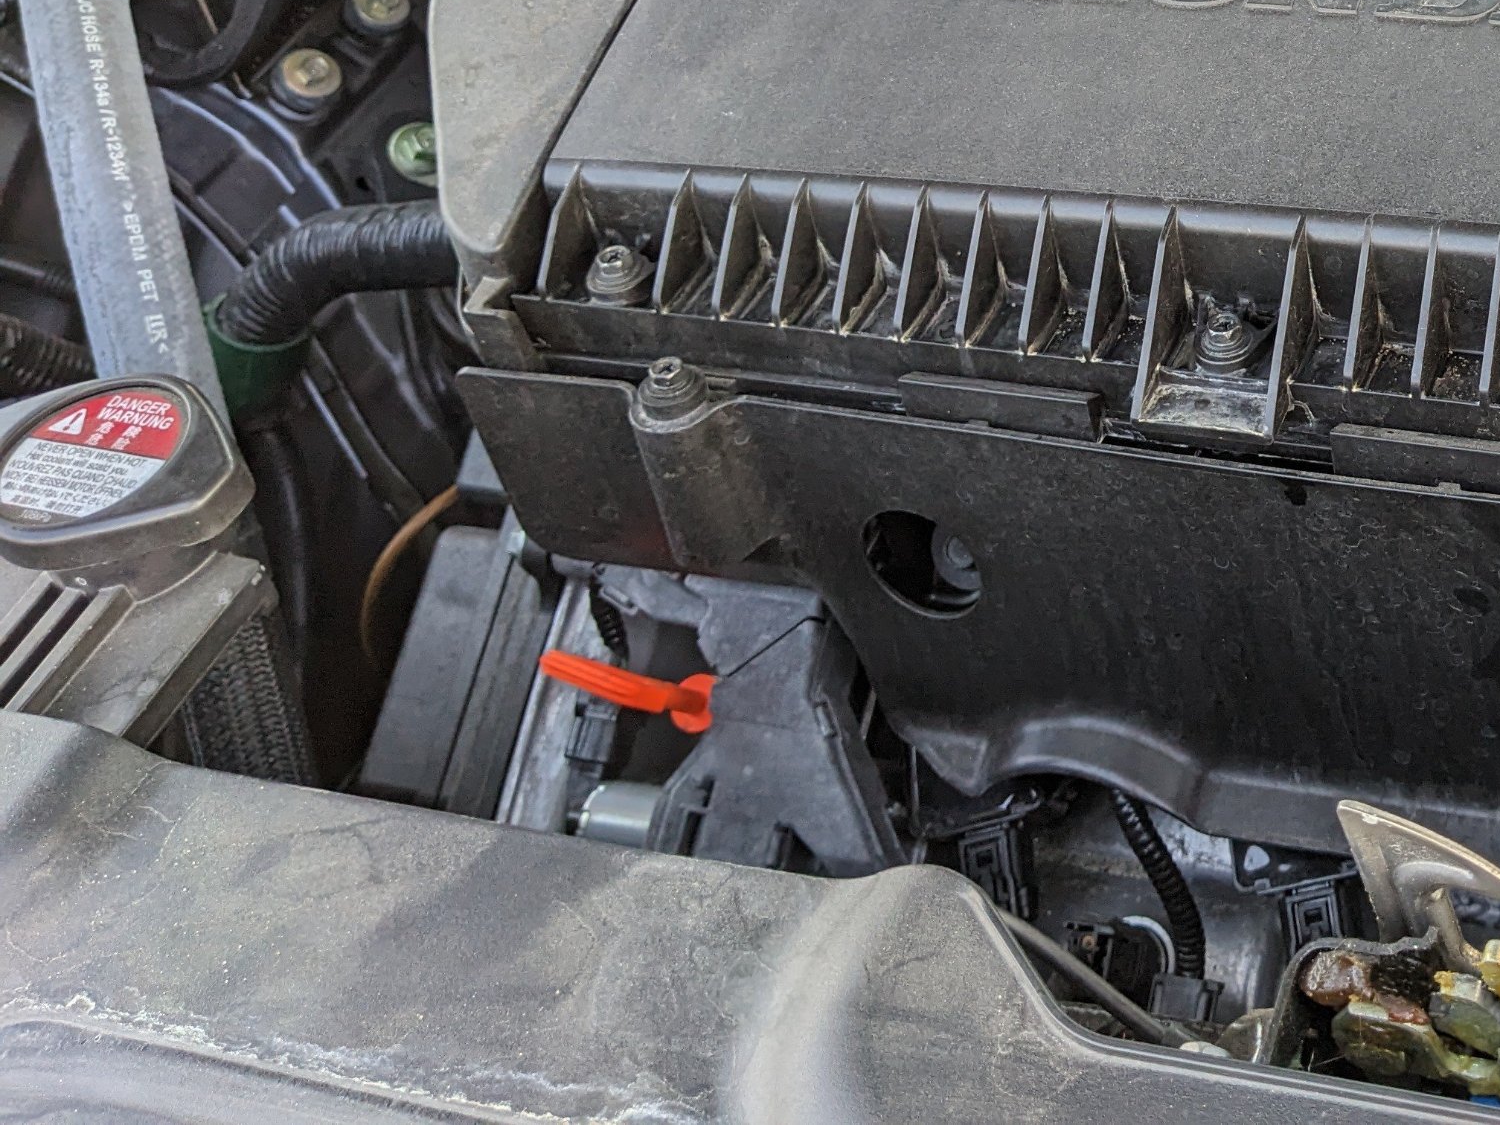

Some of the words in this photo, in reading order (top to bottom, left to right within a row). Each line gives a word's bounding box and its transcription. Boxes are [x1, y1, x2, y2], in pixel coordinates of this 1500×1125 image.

[80, 15, 102, 53] HOSE
[136, 268, 160, 303] PET
[106, 395, 173, 415] DANGER
[96, 407, 175, 430] WARNUNG
[25, 451, 42, 461] Hot
[42, 454, 73, 466] coolant
[73, 458, 86, 468] will
[86, 460, 110, 472] scald
[36, 441, 68, 456] NEVER
[67, 445, 93, 458] OPEN
[94, 449, 126, 465] WHEN
[54, 465, 71, 477] PAS
[71, 468, 105, 484] QUAND
[68, 478, 94, 492] MOTOR
